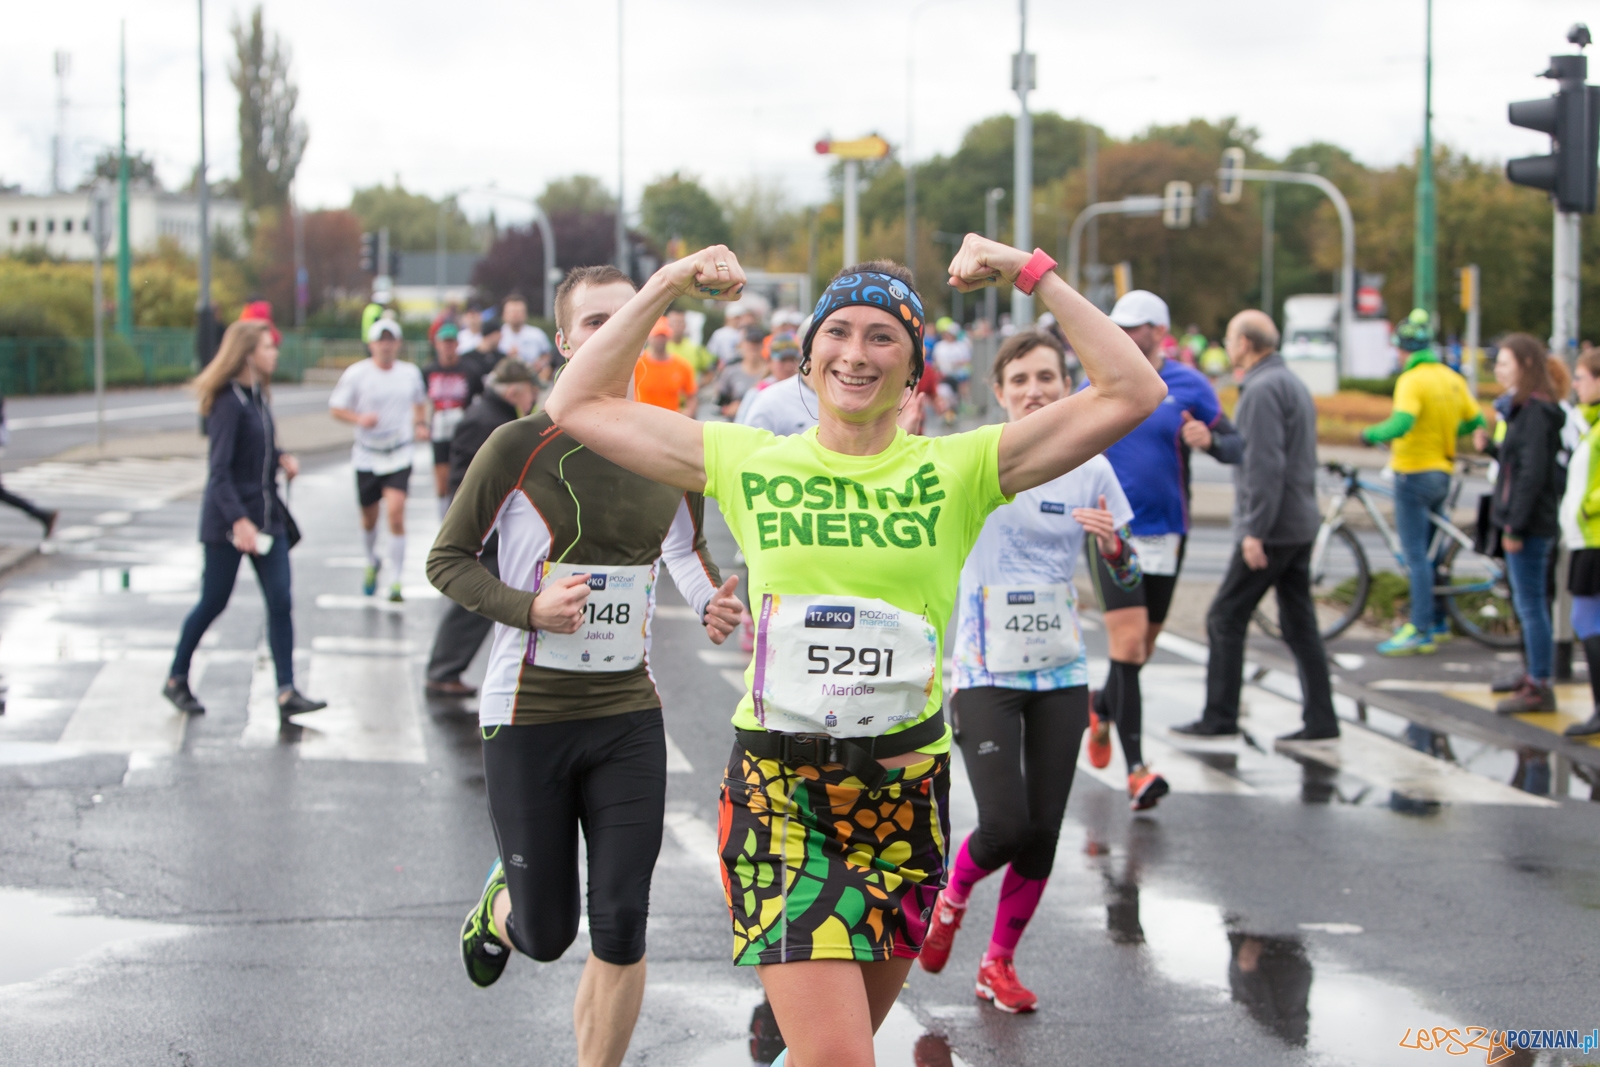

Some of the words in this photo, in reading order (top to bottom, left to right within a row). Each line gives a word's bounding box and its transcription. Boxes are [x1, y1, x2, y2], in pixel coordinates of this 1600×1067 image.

[741, 462, 946, 511] POSITIVE
[756, 505, 941, 551] ENERGY
[809, 611, 825, 622] 17.
[826, 611, 852, 623] PKO
[859, 618, 899, 628] maraton
[1005, 613, 1062, 633] 4264
[584, 630, 615, 640] Jakub
[808, 645, 894, 678] 5291
[821, 683, 876, 697] Mariola
[857, 715, 875, 726] 4F
